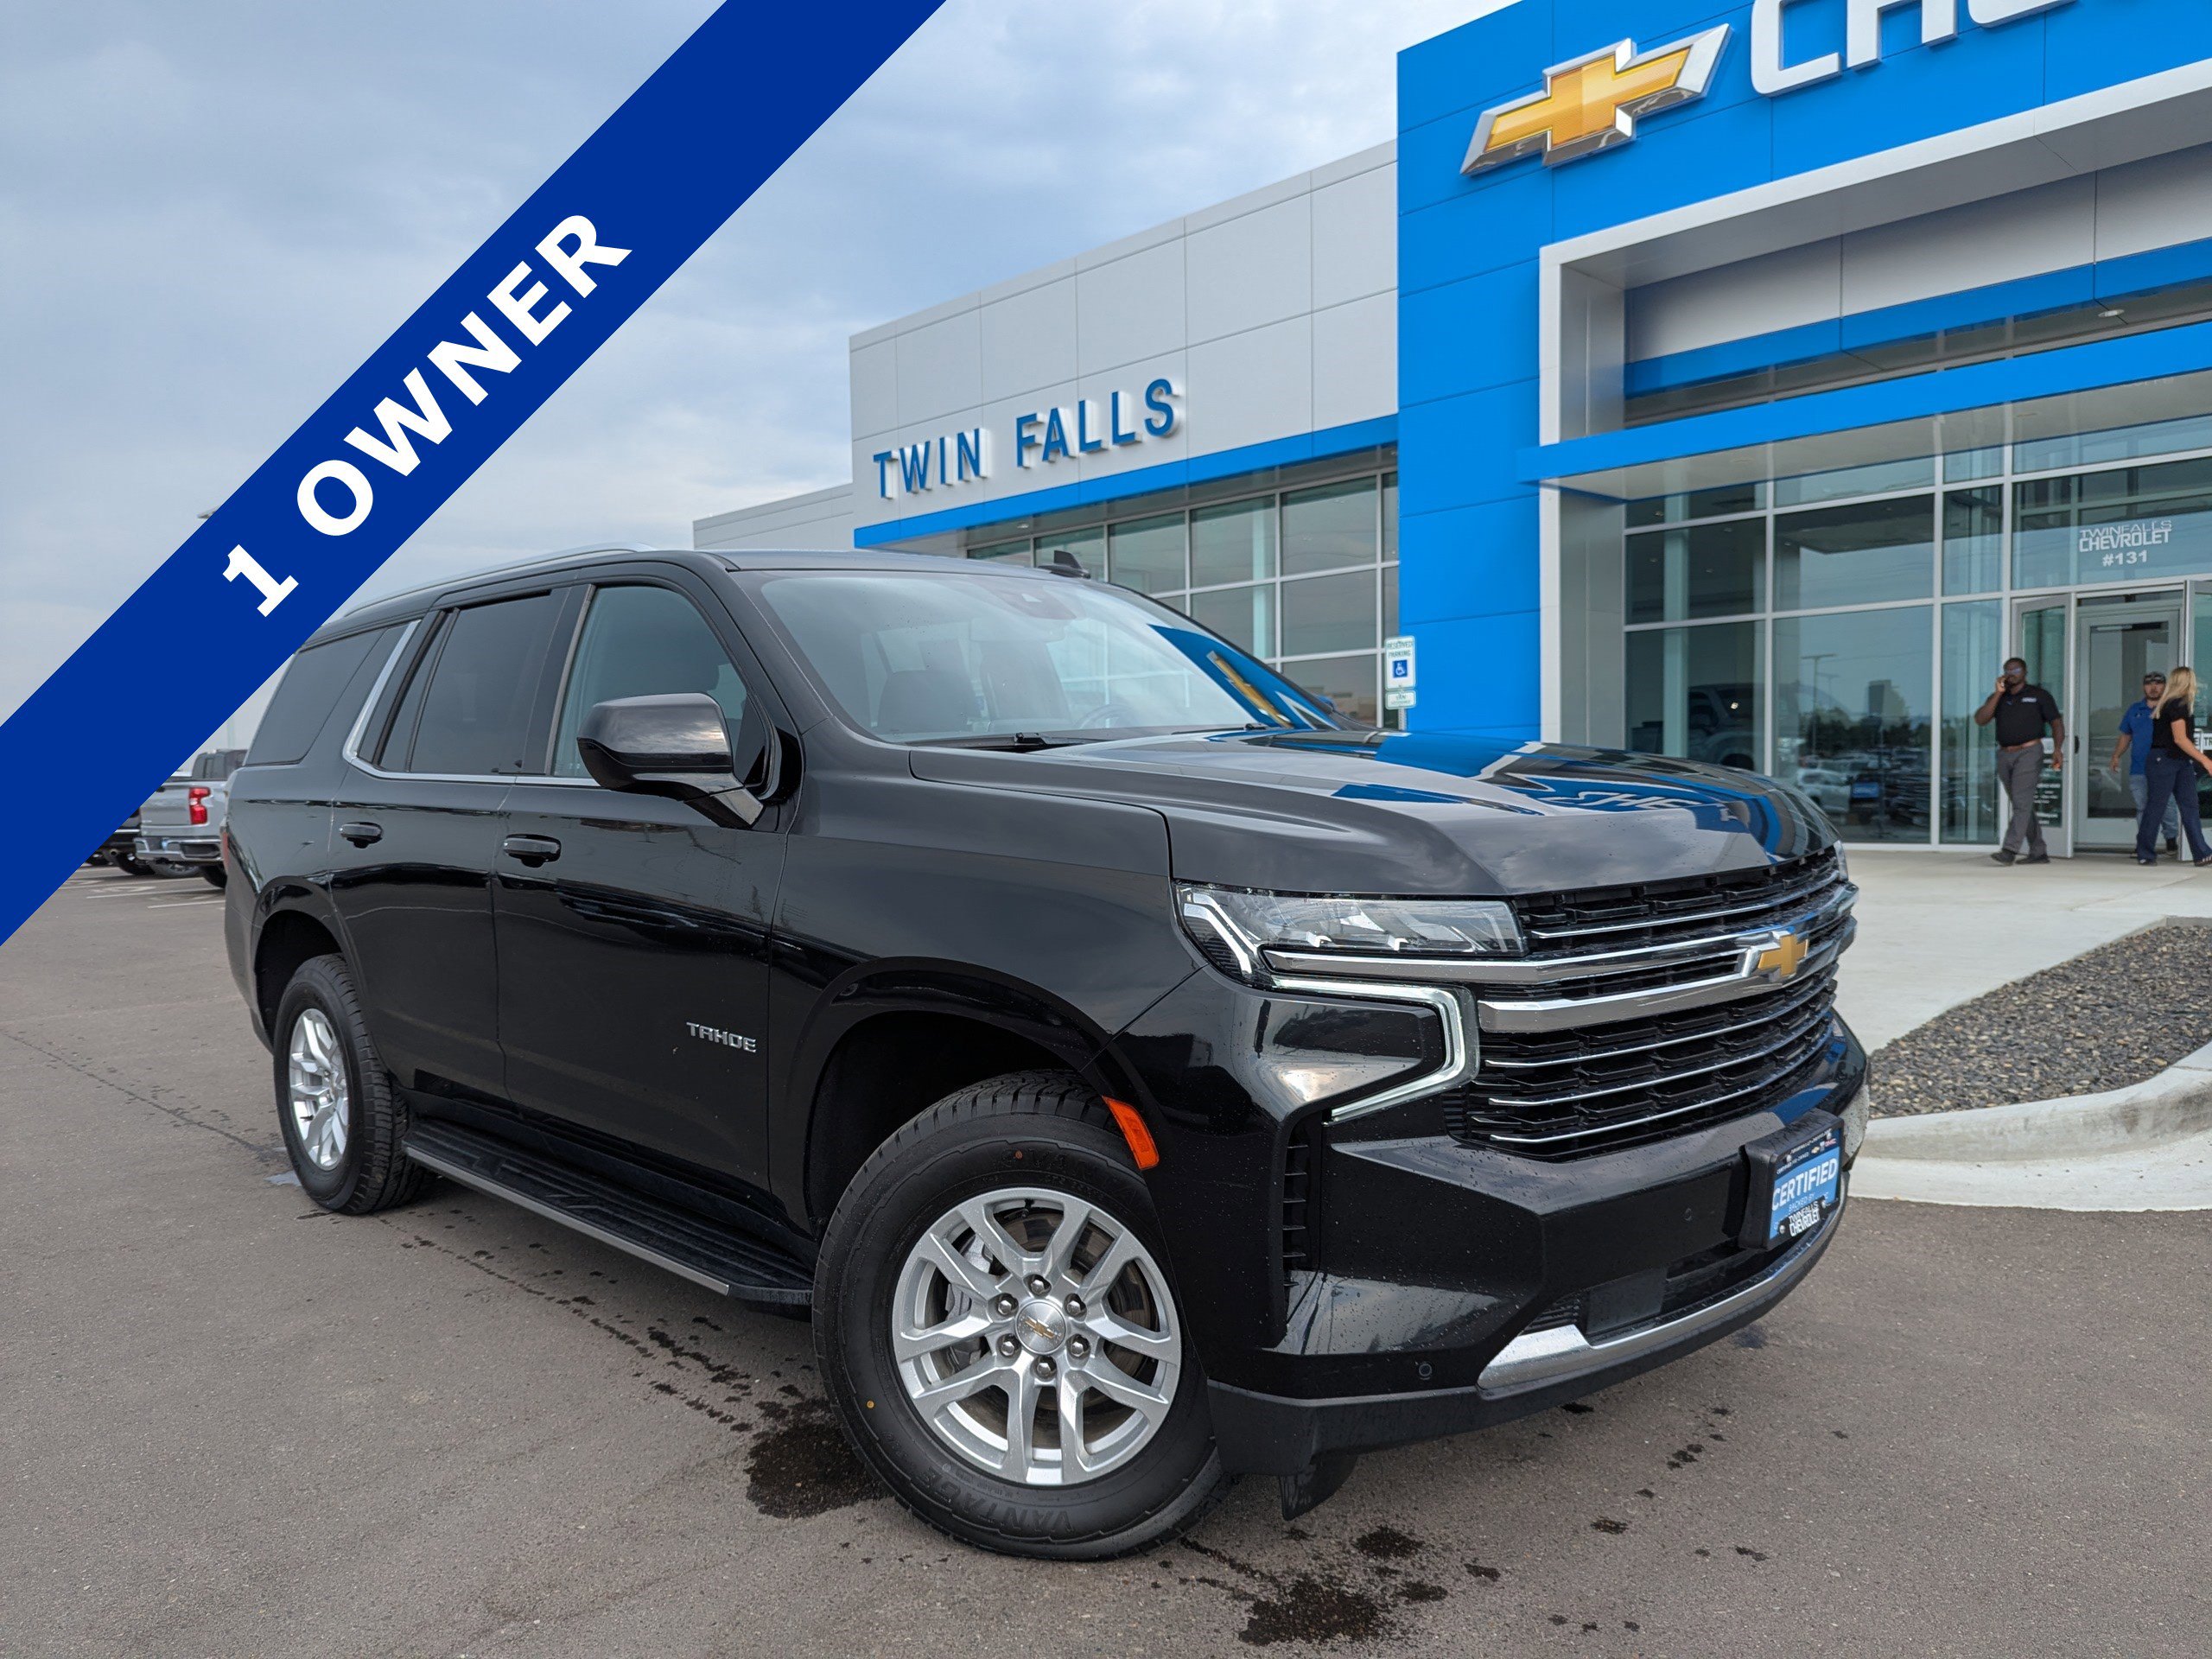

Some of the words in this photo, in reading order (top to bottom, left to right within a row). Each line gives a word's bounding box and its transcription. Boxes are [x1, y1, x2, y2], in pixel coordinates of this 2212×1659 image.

[873, 428, 987, 499] TWIN
[1016, 378, 1178, 469] FALLS
[2079, 529, 2172, 552] CHEVROLET
[2102, 550, 2147, 567] #131
[686, 1021, 756, 1052] TAHOE
[1771, 1158, 1838, 1211] CERTIFIED
[1789, 1209, 1820, 1236] CHEVROLET
